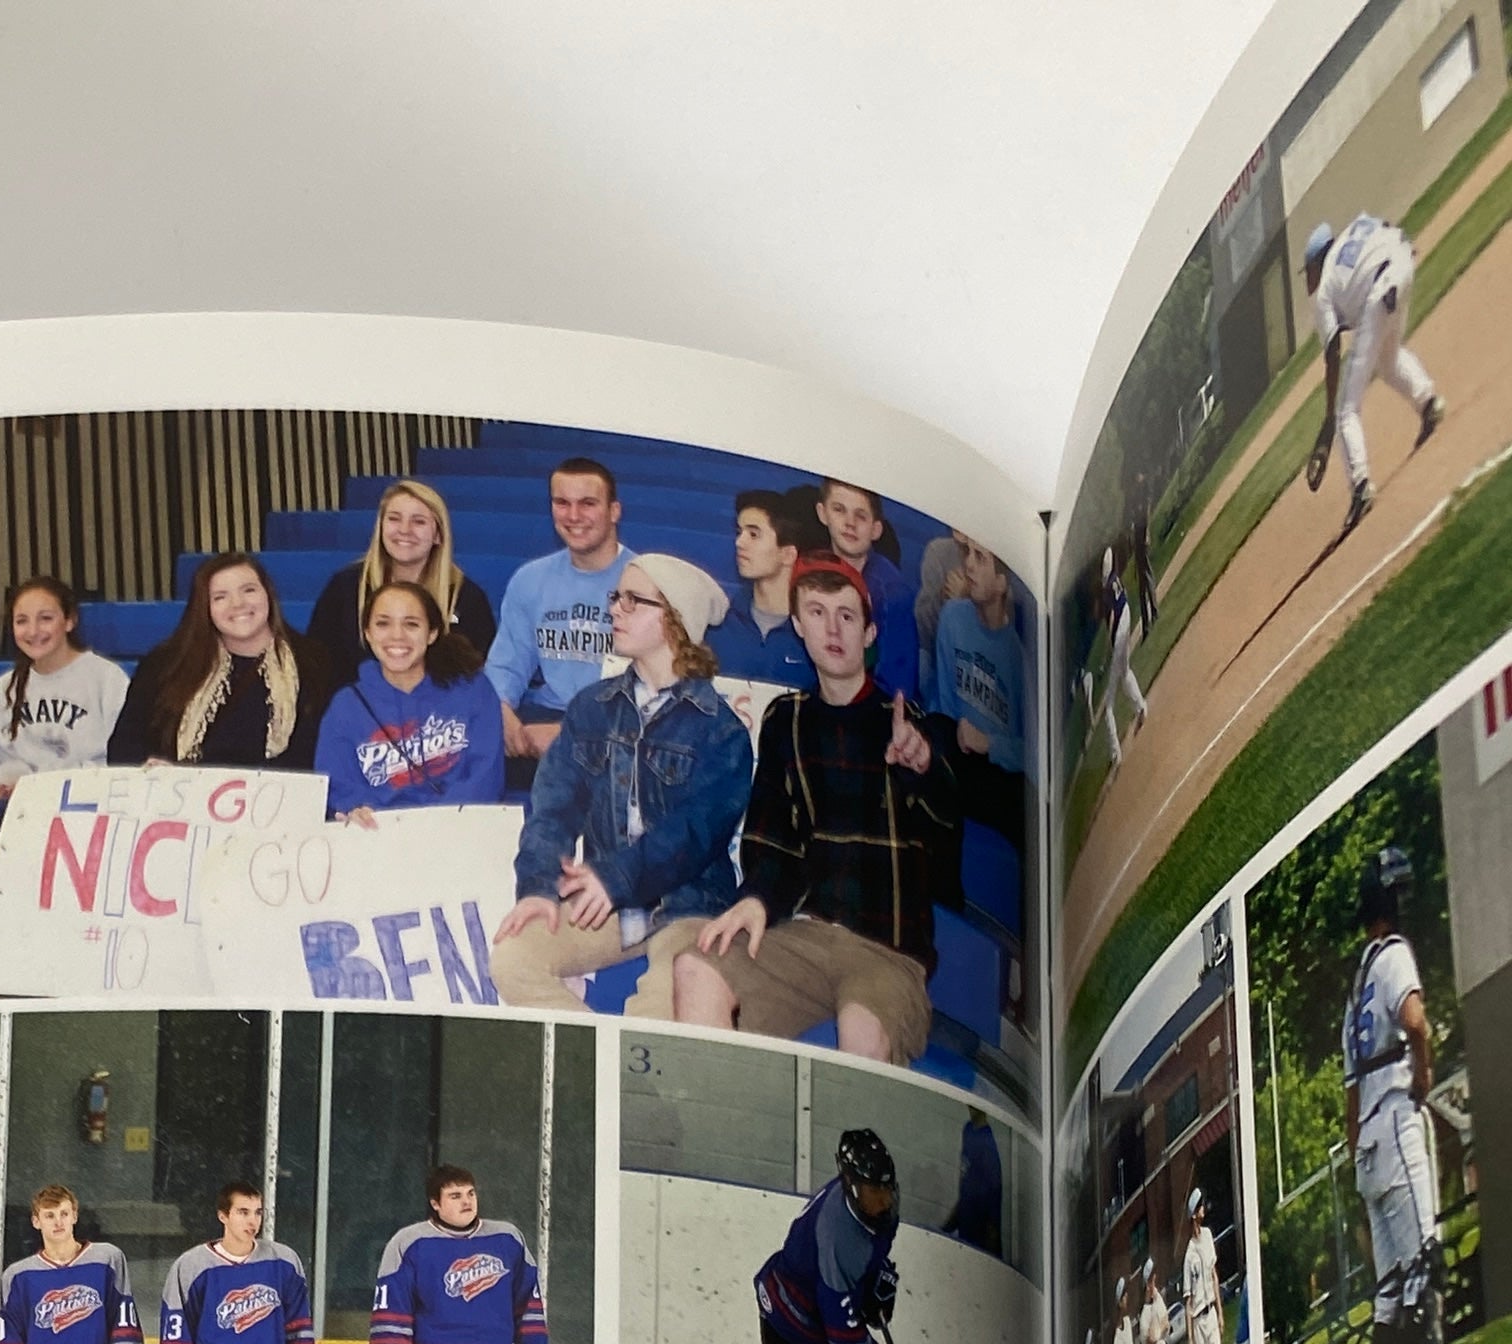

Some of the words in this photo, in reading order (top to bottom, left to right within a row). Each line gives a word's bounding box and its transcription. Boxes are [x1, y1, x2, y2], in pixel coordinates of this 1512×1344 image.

[535, 627, 614, 654] CHAMPION
[20, 698, 88, 730] NAVY
[59, 778, 191, 817] LETS
[207, 780, 286, 829] GO
[248, 836, 332, 907] GO
[628, 1046, 663, 1076] 3.
